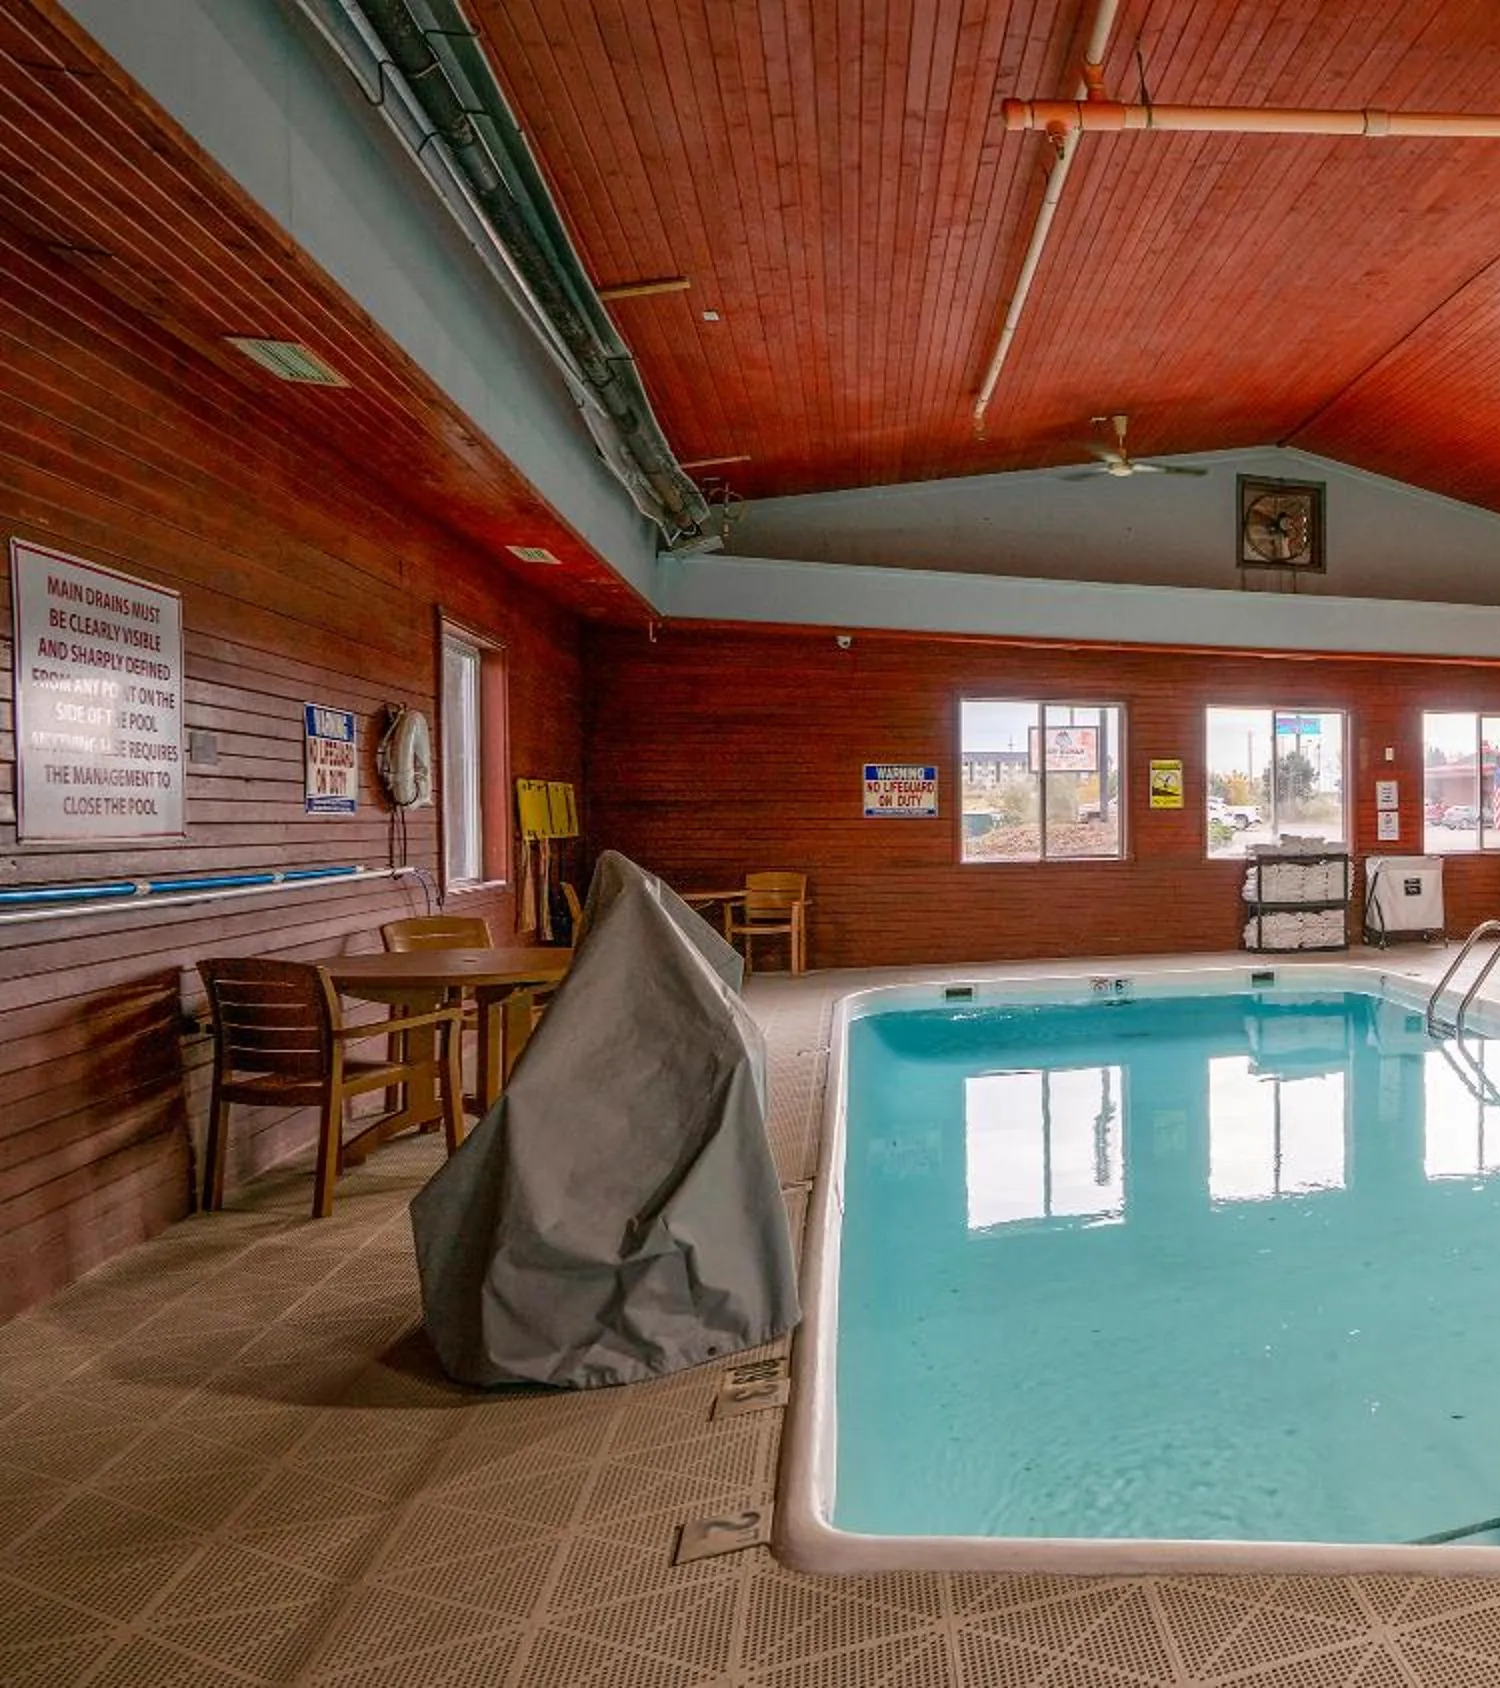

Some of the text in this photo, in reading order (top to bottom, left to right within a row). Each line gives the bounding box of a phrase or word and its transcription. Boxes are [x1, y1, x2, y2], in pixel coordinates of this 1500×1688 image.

[48, 576, 160, 624] MAIN DRAINS MUST
[49, 608, 161, 652] BE CLEARLY VISIBLE
[38, 638, 170, 681] AND SHARPLY DEFINED
[73, 678, 99, 698] ANY
[101, 680, 137, 704] POT
[139, 687, 155, 707] ON
[156, 690, 175, 709] THE
[55, 701, 158, 732] SIDE OF TE POOL
[129, 741, 178, 763] REQUIRES
[44, 764, 171, 788] THE MANAGEMENT TO
[867, 781, 880, 793] NO
[63, 796, 159, 816] CLOSE THE POOL
[879, 795, 922, 807] ON DUTY
